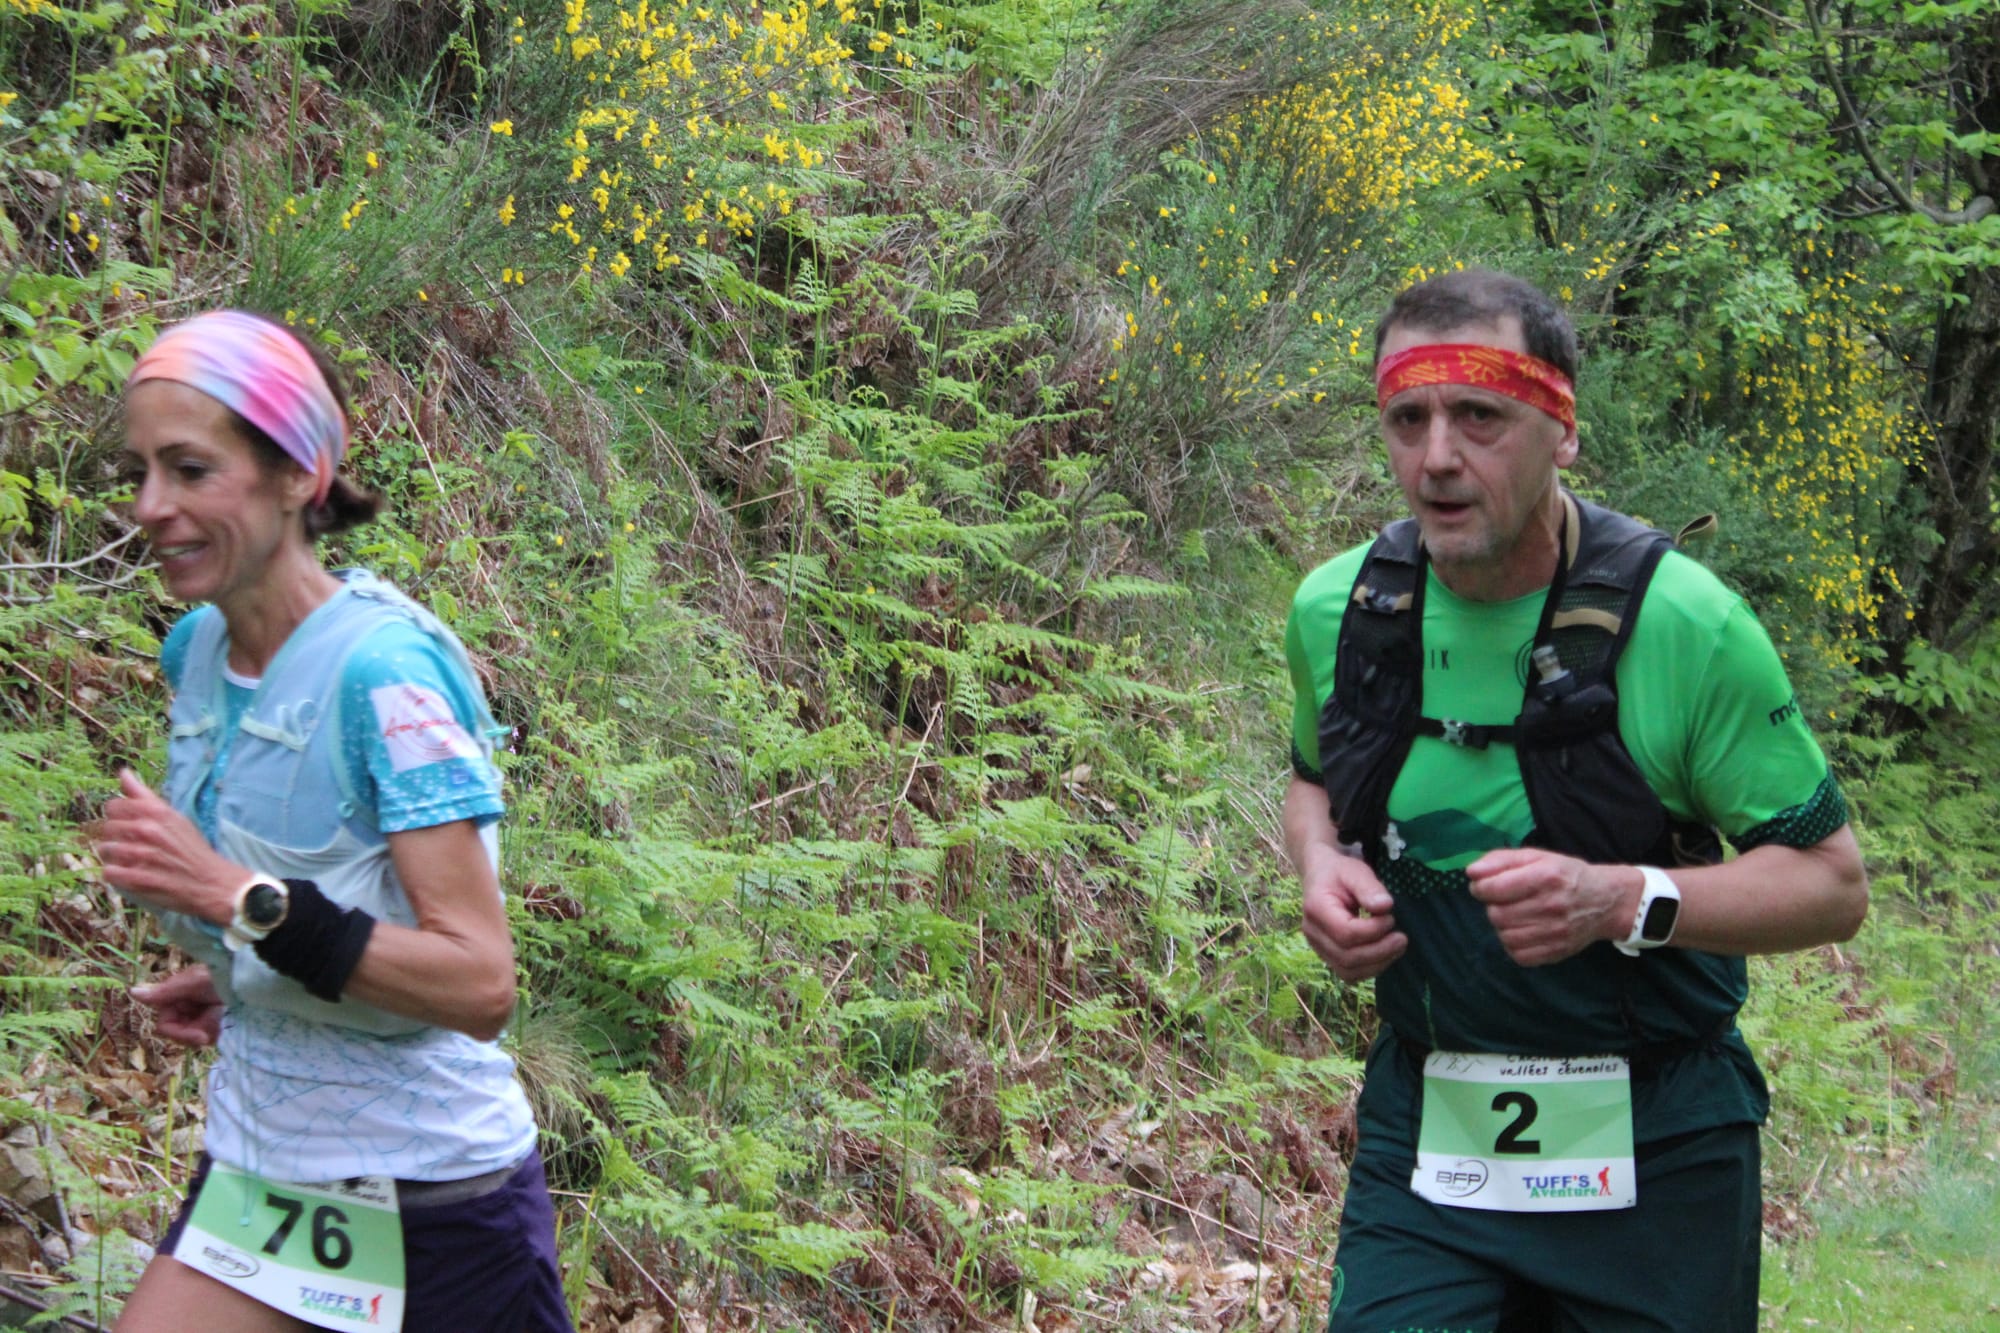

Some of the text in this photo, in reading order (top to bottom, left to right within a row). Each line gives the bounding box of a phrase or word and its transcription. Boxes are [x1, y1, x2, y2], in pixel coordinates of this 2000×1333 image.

[1491, 1090, 1541, 1154] 2
[1435, 1171, 1482, 1185] BFP
[1522, 1174, 1591, 1190] TUFF'S
[1530, 1186, 1599, 1199] Aventure
[261, 1192, 353, 1270] 76
[298, 1286, 364, 1311] TUFF'S
